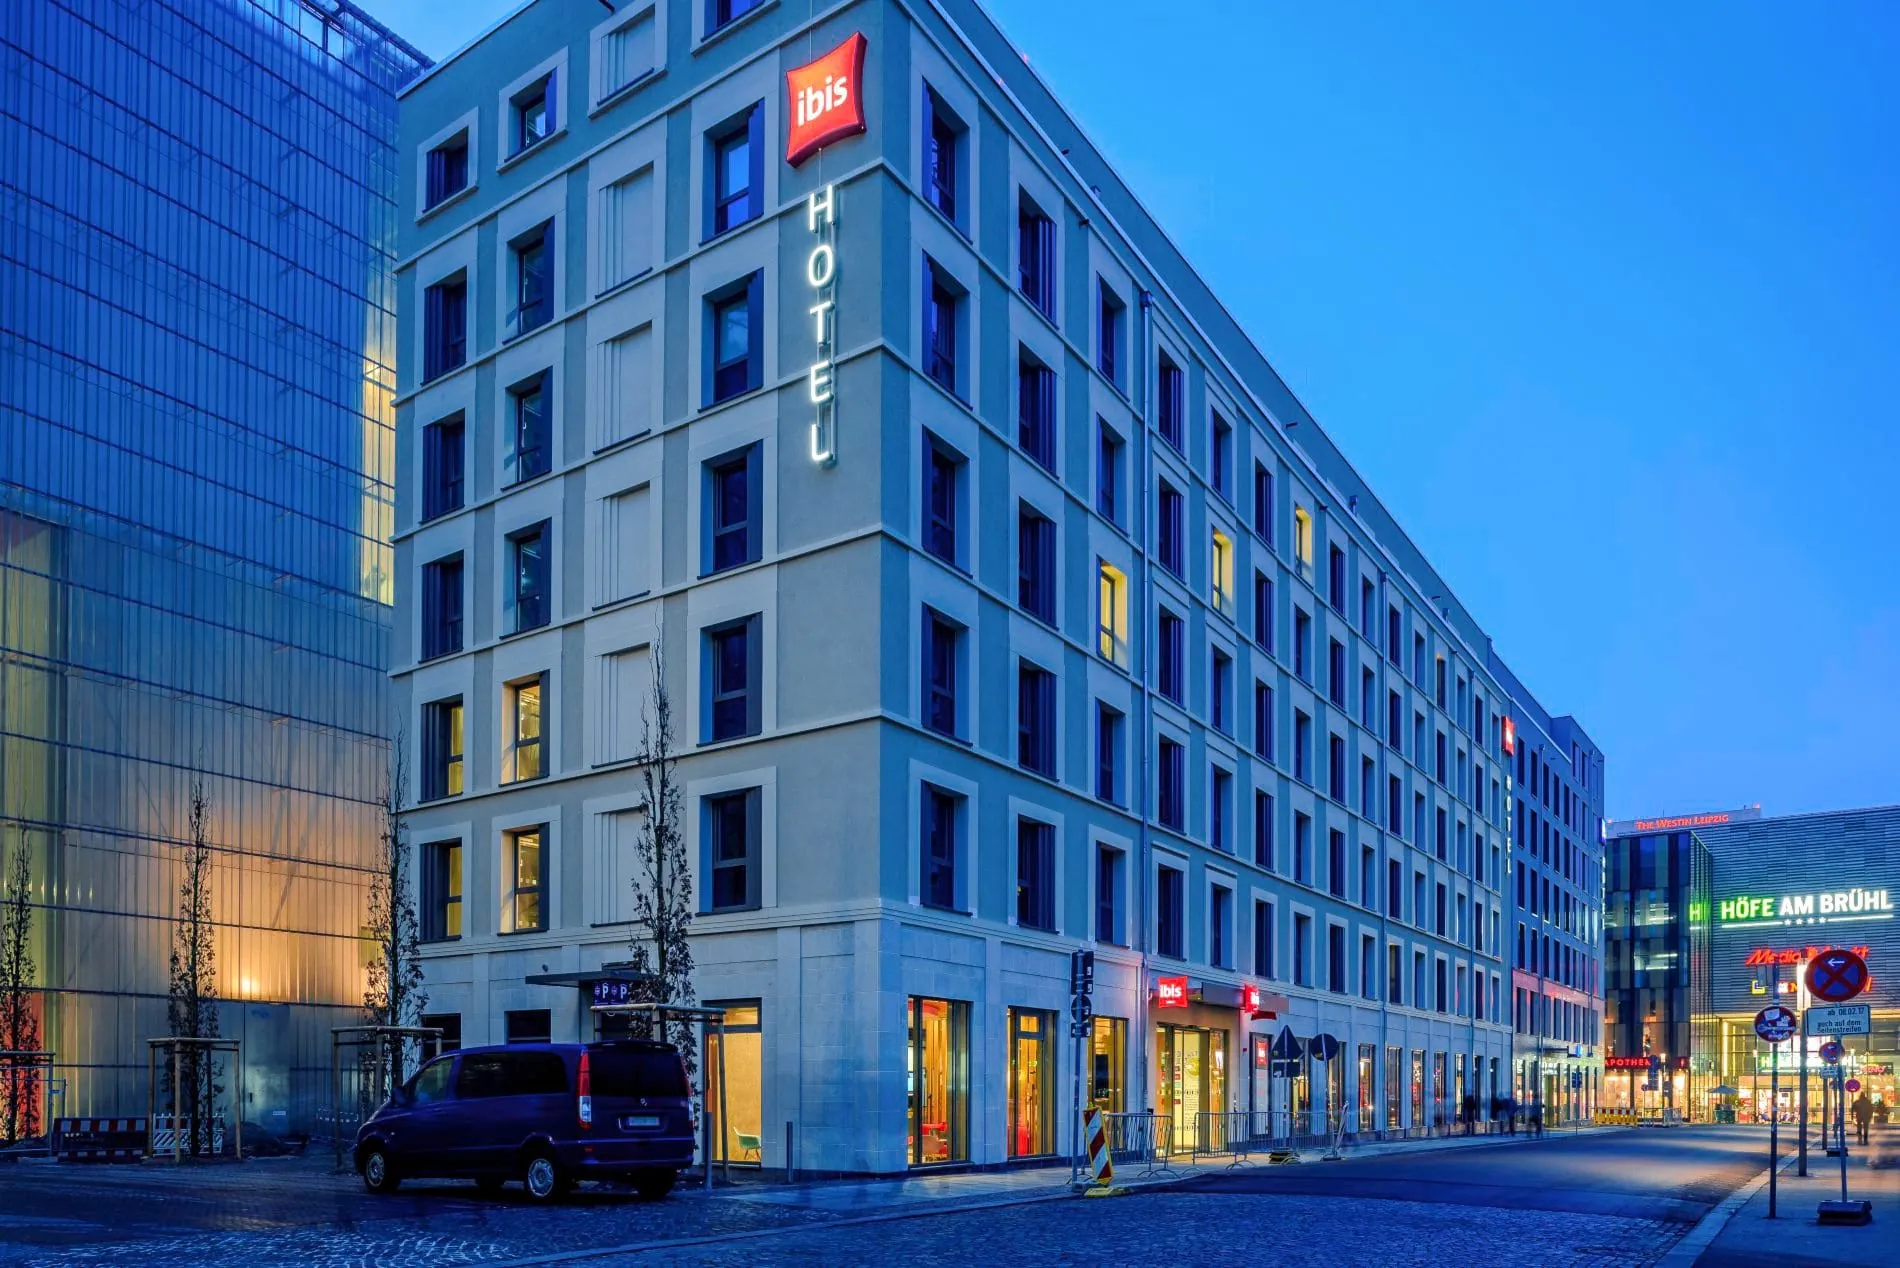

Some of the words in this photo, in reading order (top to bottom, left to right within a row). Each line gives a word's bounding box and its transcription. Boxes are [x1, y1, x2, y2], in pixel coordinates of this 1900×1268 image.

[798, 75, 848, 126] ibis
[808, 184, 834, 462] HOTEL
[1636, 820, 1654, 830] THE
[1656, 817, 1692, 829] WESTIN
[1694, 814, 1729, 825] LEIPZIG
[1720, 896, 1774, 920] HÖFE
[1779, 896, 1814, 915] AM
[1819, 889, 1894, 914] BRÜHL
[1160, 984, 1182, 998] ibis
